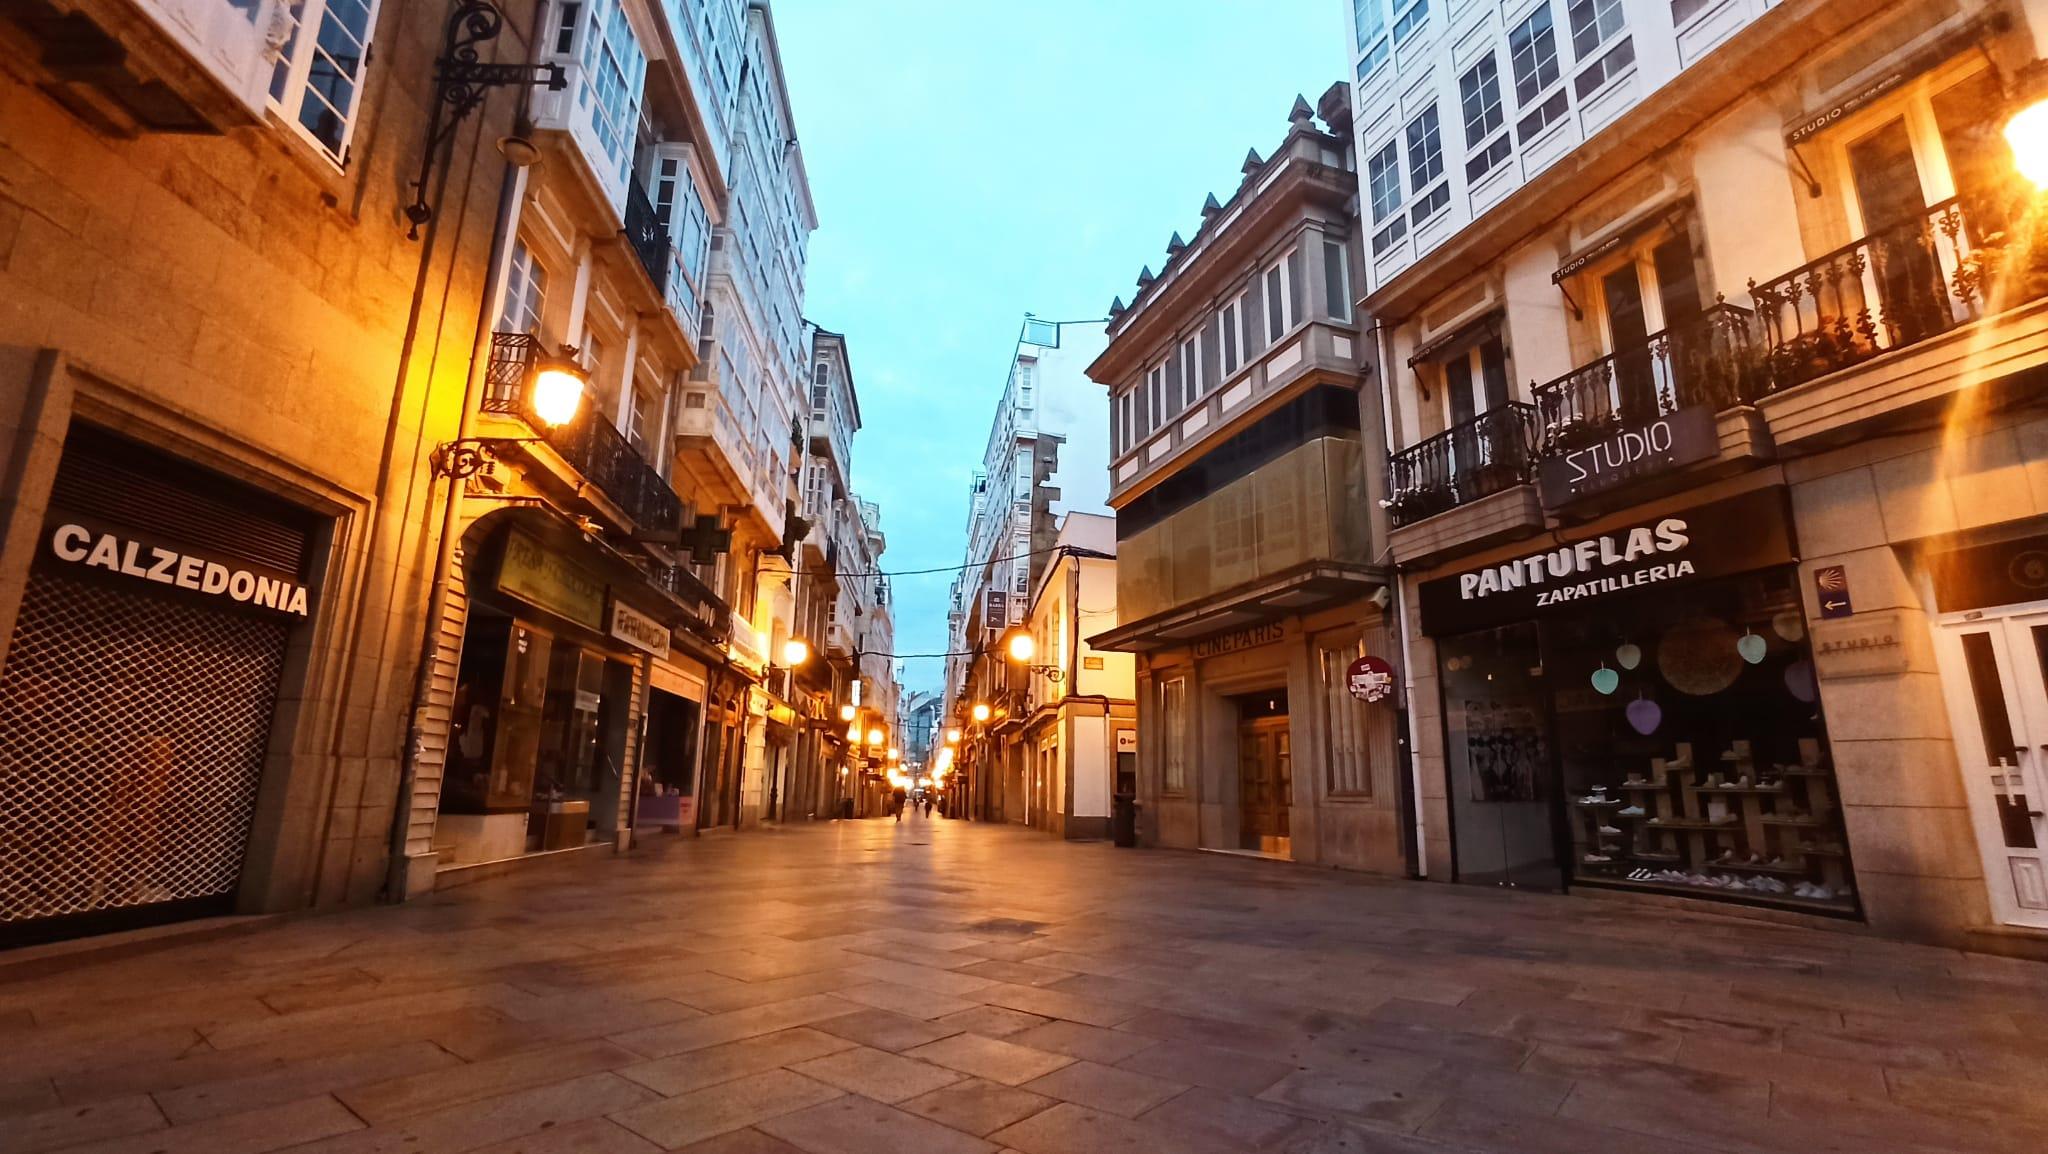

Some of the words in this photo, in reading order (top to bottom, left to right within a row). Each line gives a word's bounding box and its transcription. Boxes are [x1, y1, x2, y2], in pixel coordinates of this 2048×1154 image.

[1792, 107, 1842, 140] STUDIO
[1556, 257, 1585, 278] STUDIO
[1566, 421, 1672, 483] STUDIO
[53, 524, 308, 616] CALZEDONIA
[1460, 518, 1689, 600] PANTUFLAS
[1536, 560, 1695, 607] ZAPATILLERIA
[1197, 631, 1231, 657] CINE
[1233, 622, 1285, 649] PARIS
[1822, 634, 1893, 656] STUDIO
